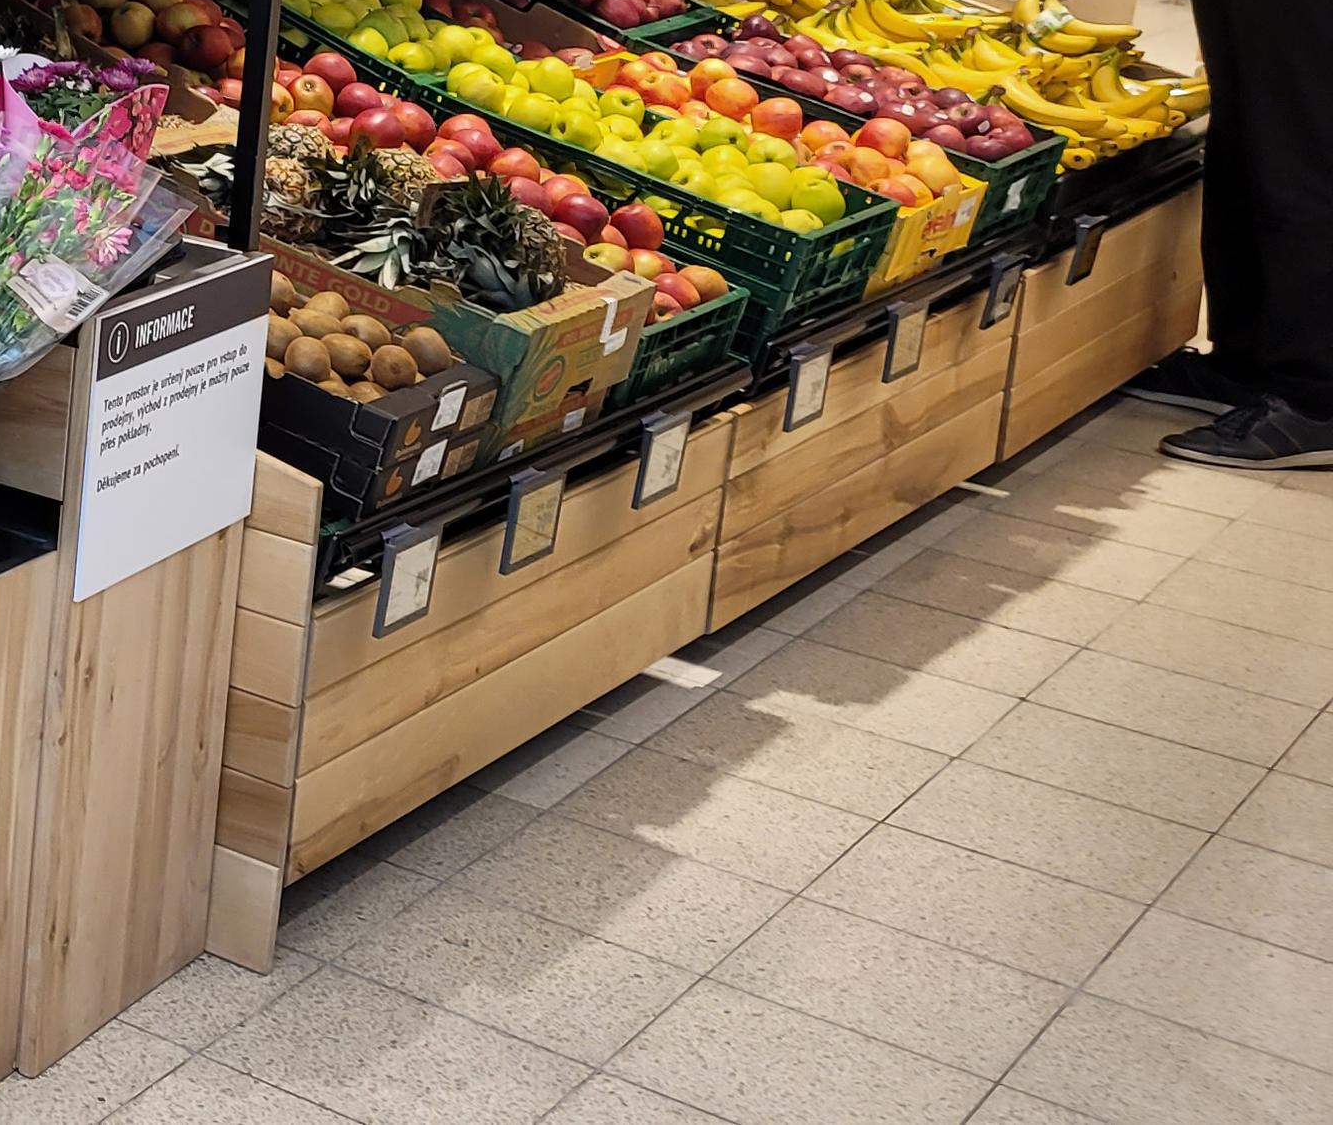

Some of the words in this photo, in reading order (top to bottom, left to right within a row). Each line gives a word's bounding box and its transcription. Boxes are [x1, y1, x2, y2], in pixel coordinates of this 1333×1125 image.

[326, 278, 391, 313] GOLD
[134, 305, 195, 349] INFORMACE
[103, 396, 124, 412] Tento
[125, 385, 151, 407] prostor
[151, 378, 159, 396] je
[185, 362, 205, 382] pouze
[206, 357, 218, 373] pro
[219, 349, 238, 366] vstup
[238, 343, 248, 357] do
[136, 395, 162, 420] východ
[169, 382, 199, 408] prodejny
[199, 377, 207, 395] je
[230, 362, 250, 381] pouze
[99, 438, 116, 457] přes
[117, 422, 152, 449] pokladny.
[96, 468, 131, 493] Děkujeme
[132, 464, 142, 477] za
